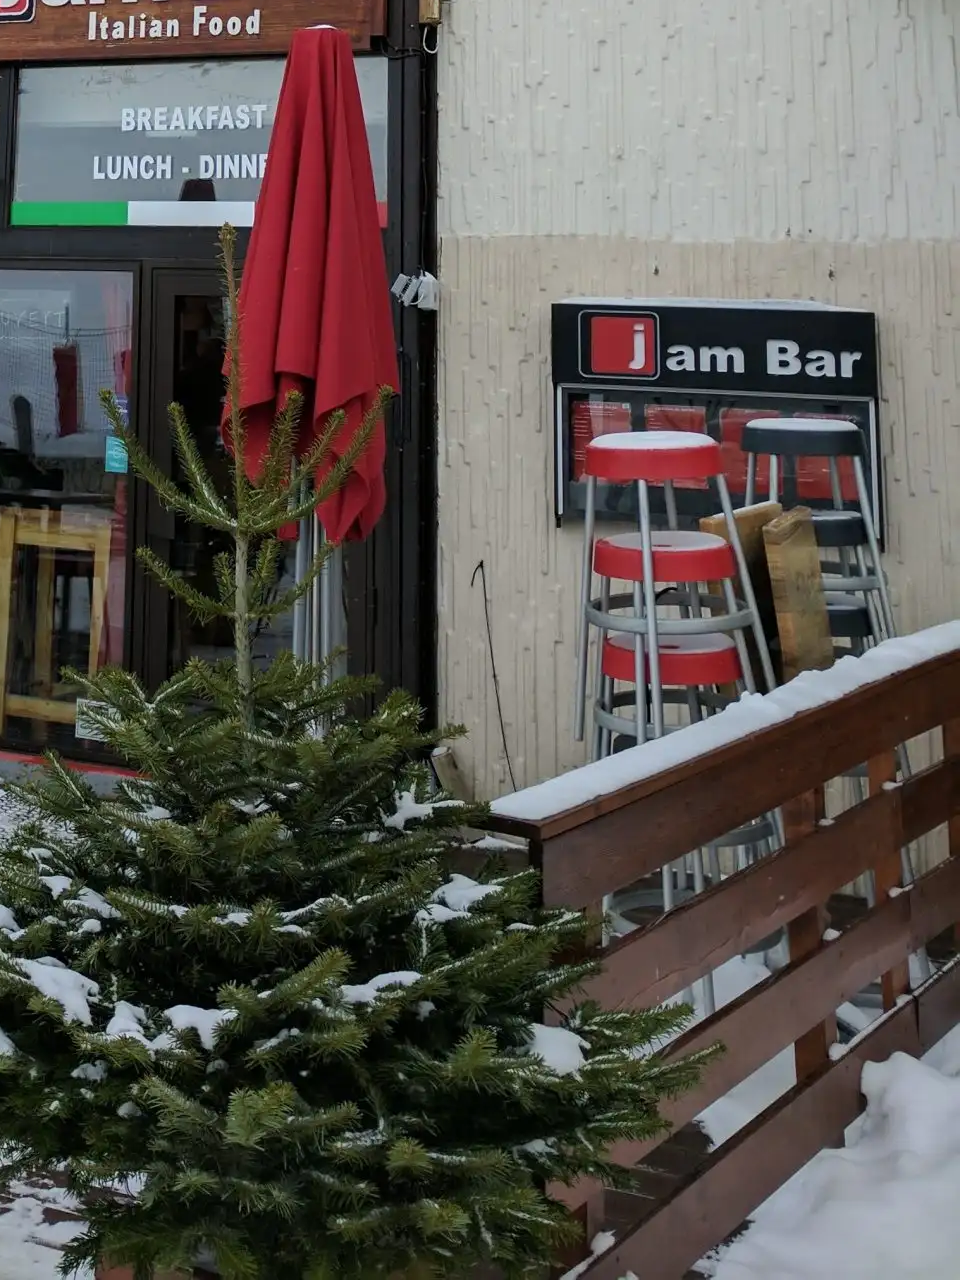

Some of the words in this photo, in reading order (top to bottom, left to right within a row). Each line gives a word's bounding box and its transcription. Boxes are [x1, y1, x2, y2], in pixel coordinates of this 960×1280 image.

[88, 10, 180, 41] Italian
[192, 5, 261, 38] Food
[121, 104, 268, 132] BREAKFAST
[93, 154, 173, 180] LUNCH
[766, 338, 862, 378] Bar
